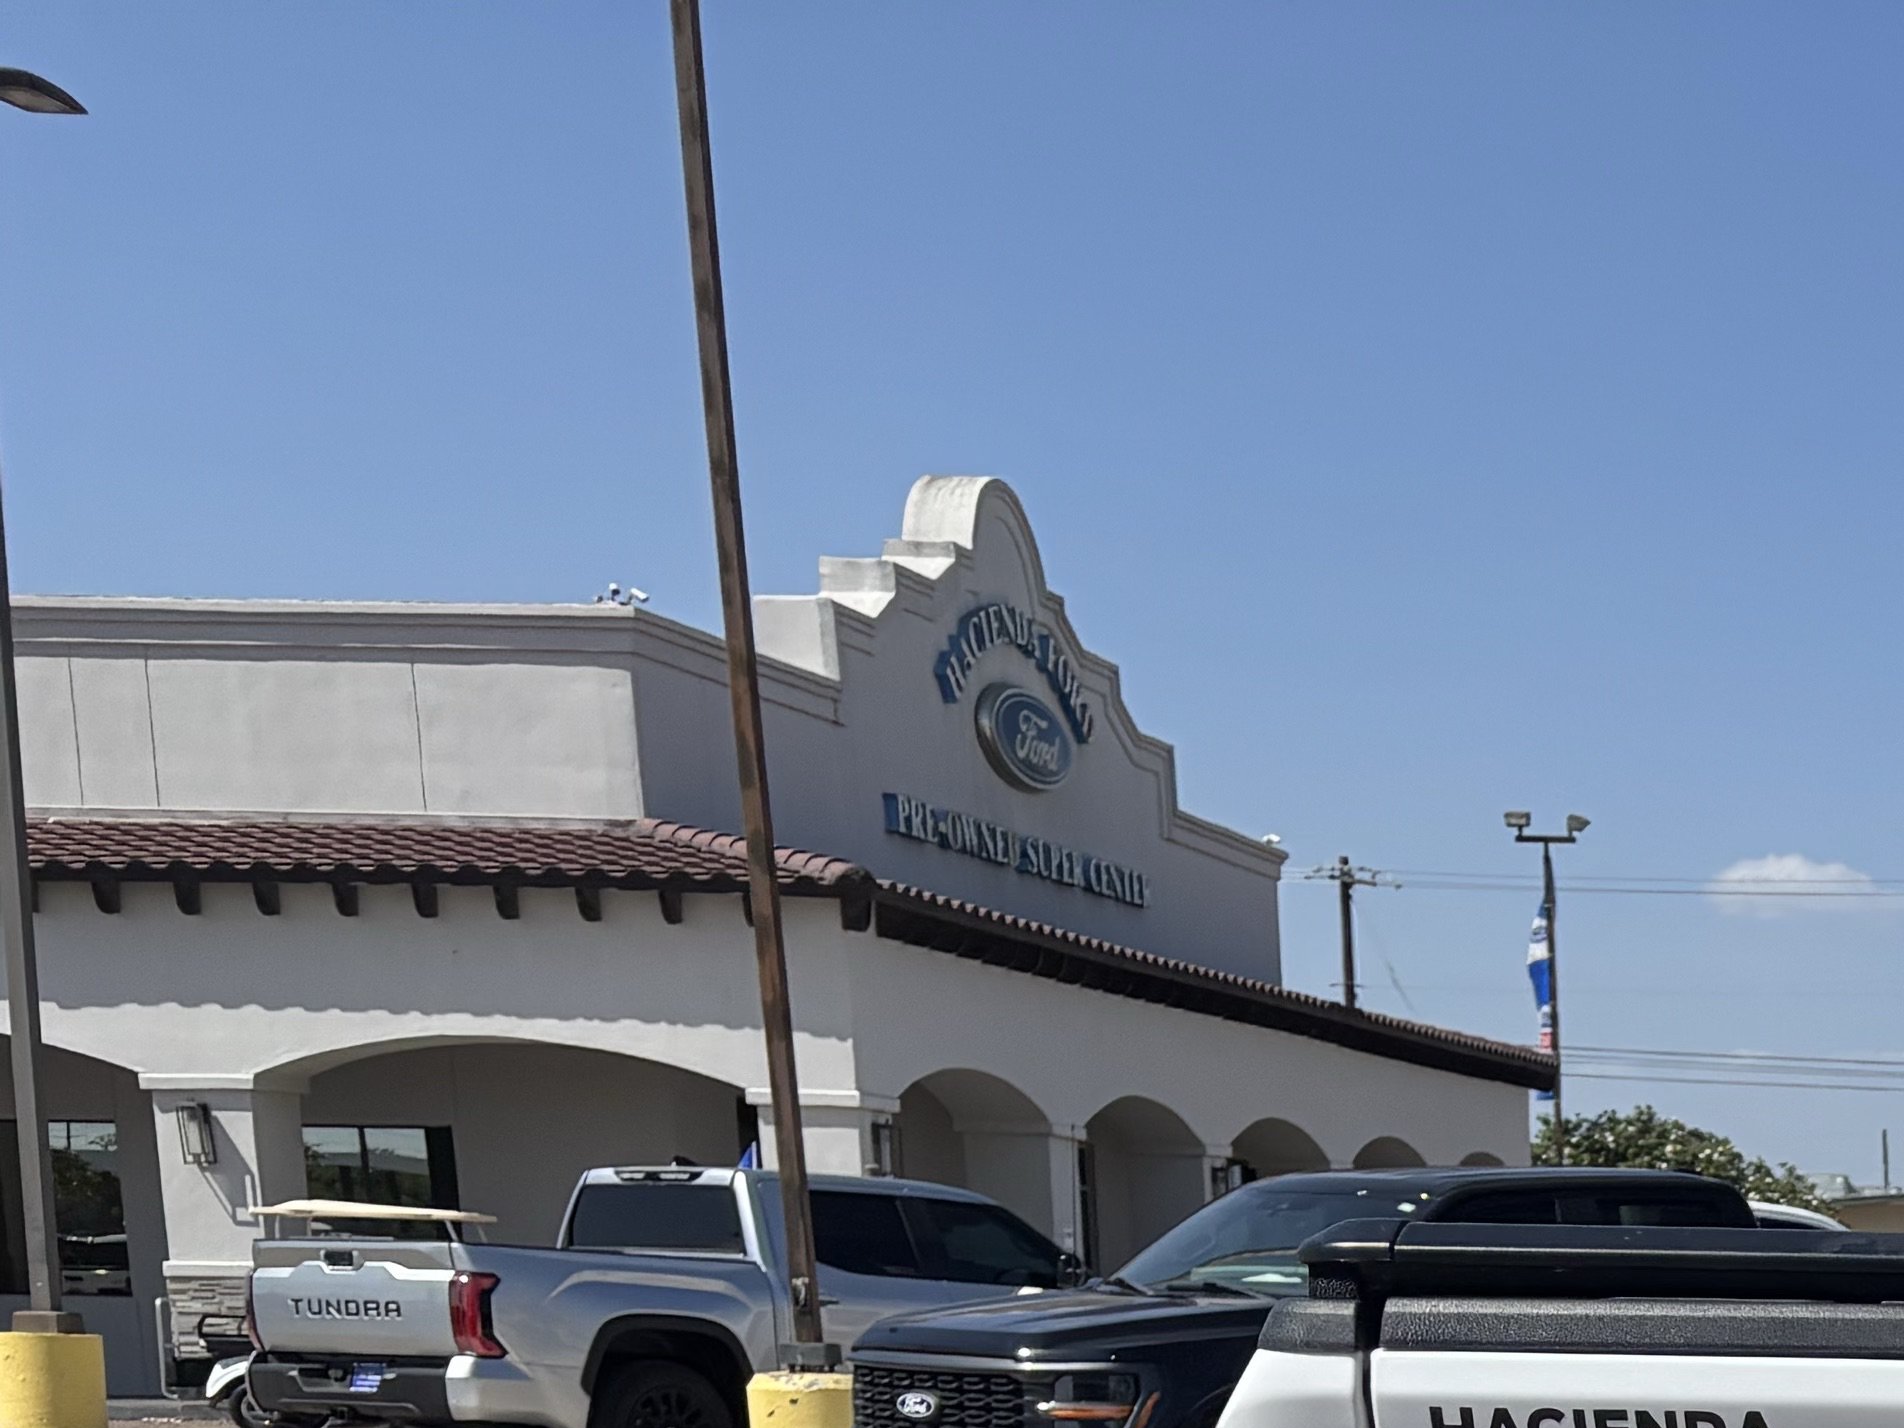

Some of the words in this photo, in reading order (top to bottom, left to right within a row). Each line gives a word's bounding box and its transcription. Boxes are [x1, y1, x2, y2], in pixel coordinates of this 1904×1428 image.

[943, 603, 1042, 700] HACIENDA
[1015, 709, 1059, 771] Ford
[897, 794, 1020, 867] PRE-OWNED
[1026, 837, 1084, 888] SUPER
[289, 1298, 402, 1319] TUNDRA
